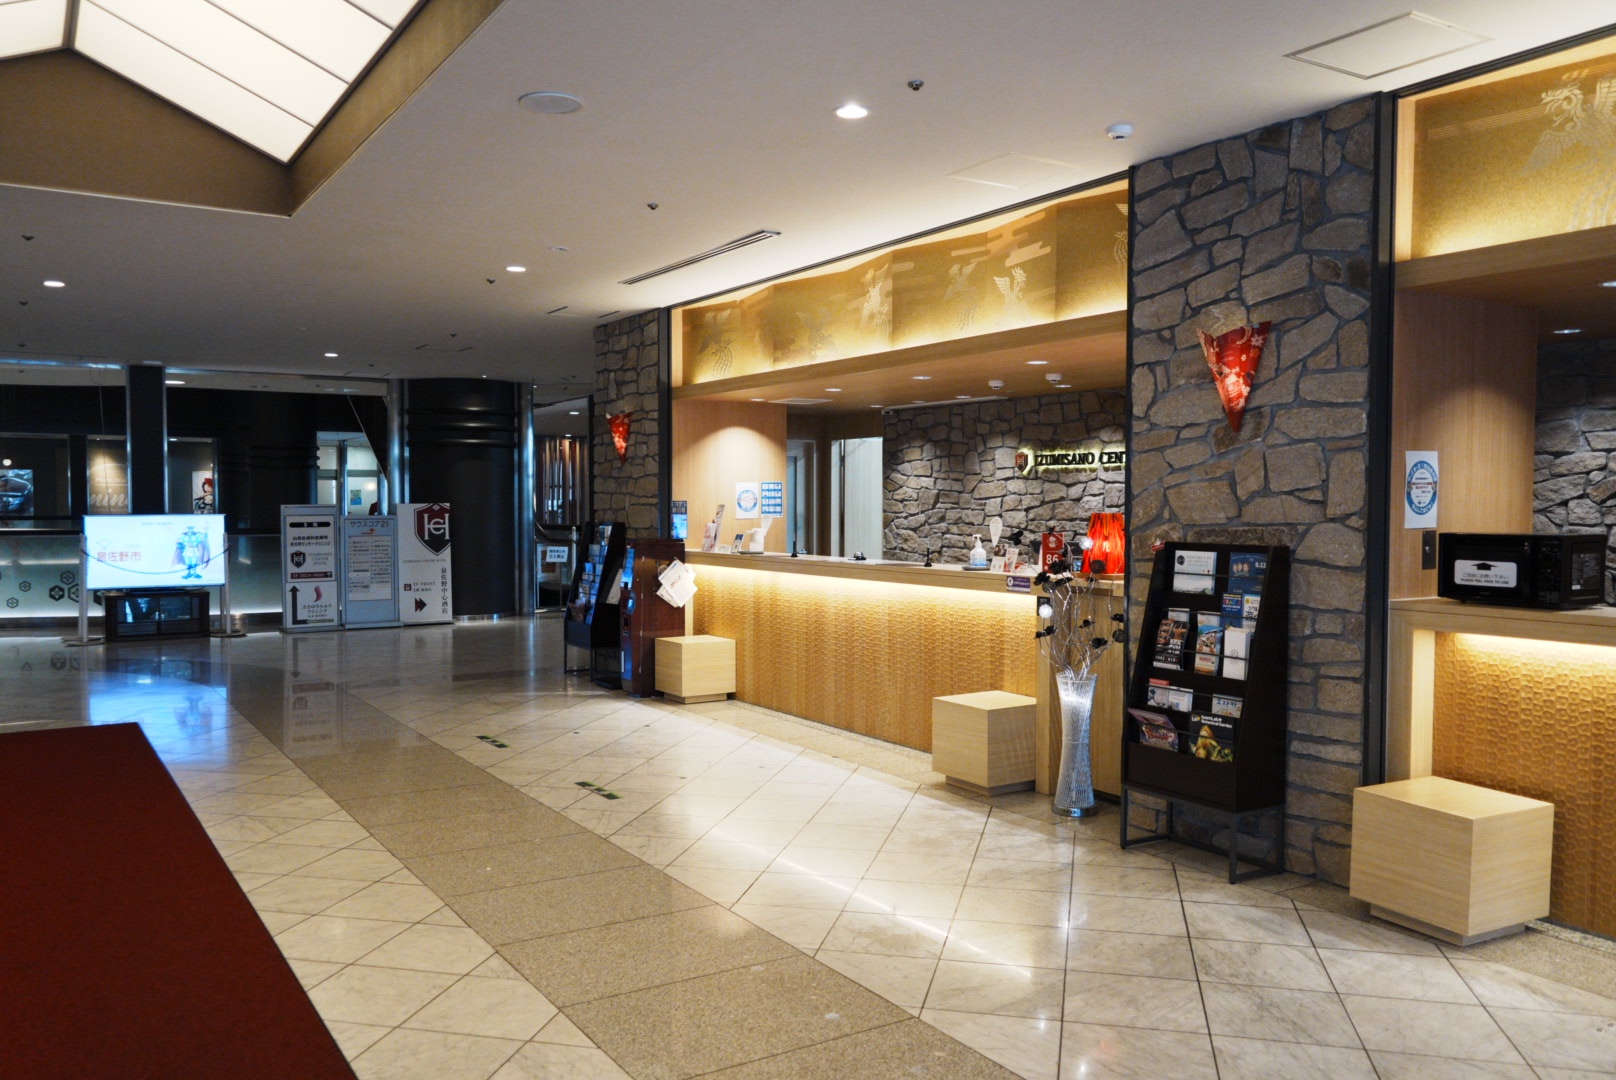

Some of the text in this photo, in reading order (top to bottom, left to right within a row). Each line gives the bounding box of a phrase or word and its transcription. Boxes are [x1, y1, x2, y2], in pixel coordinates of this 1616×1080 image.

[1035, 452, 1095, 467] IZUMISANO
[350, 520, 389, 528] サウスコア21
[97, 551, 142, 562] 泉佐野市
[1046, 553, 1059, 564] 86
[440, 566, 449, 614] 泉佐野中心酒店
